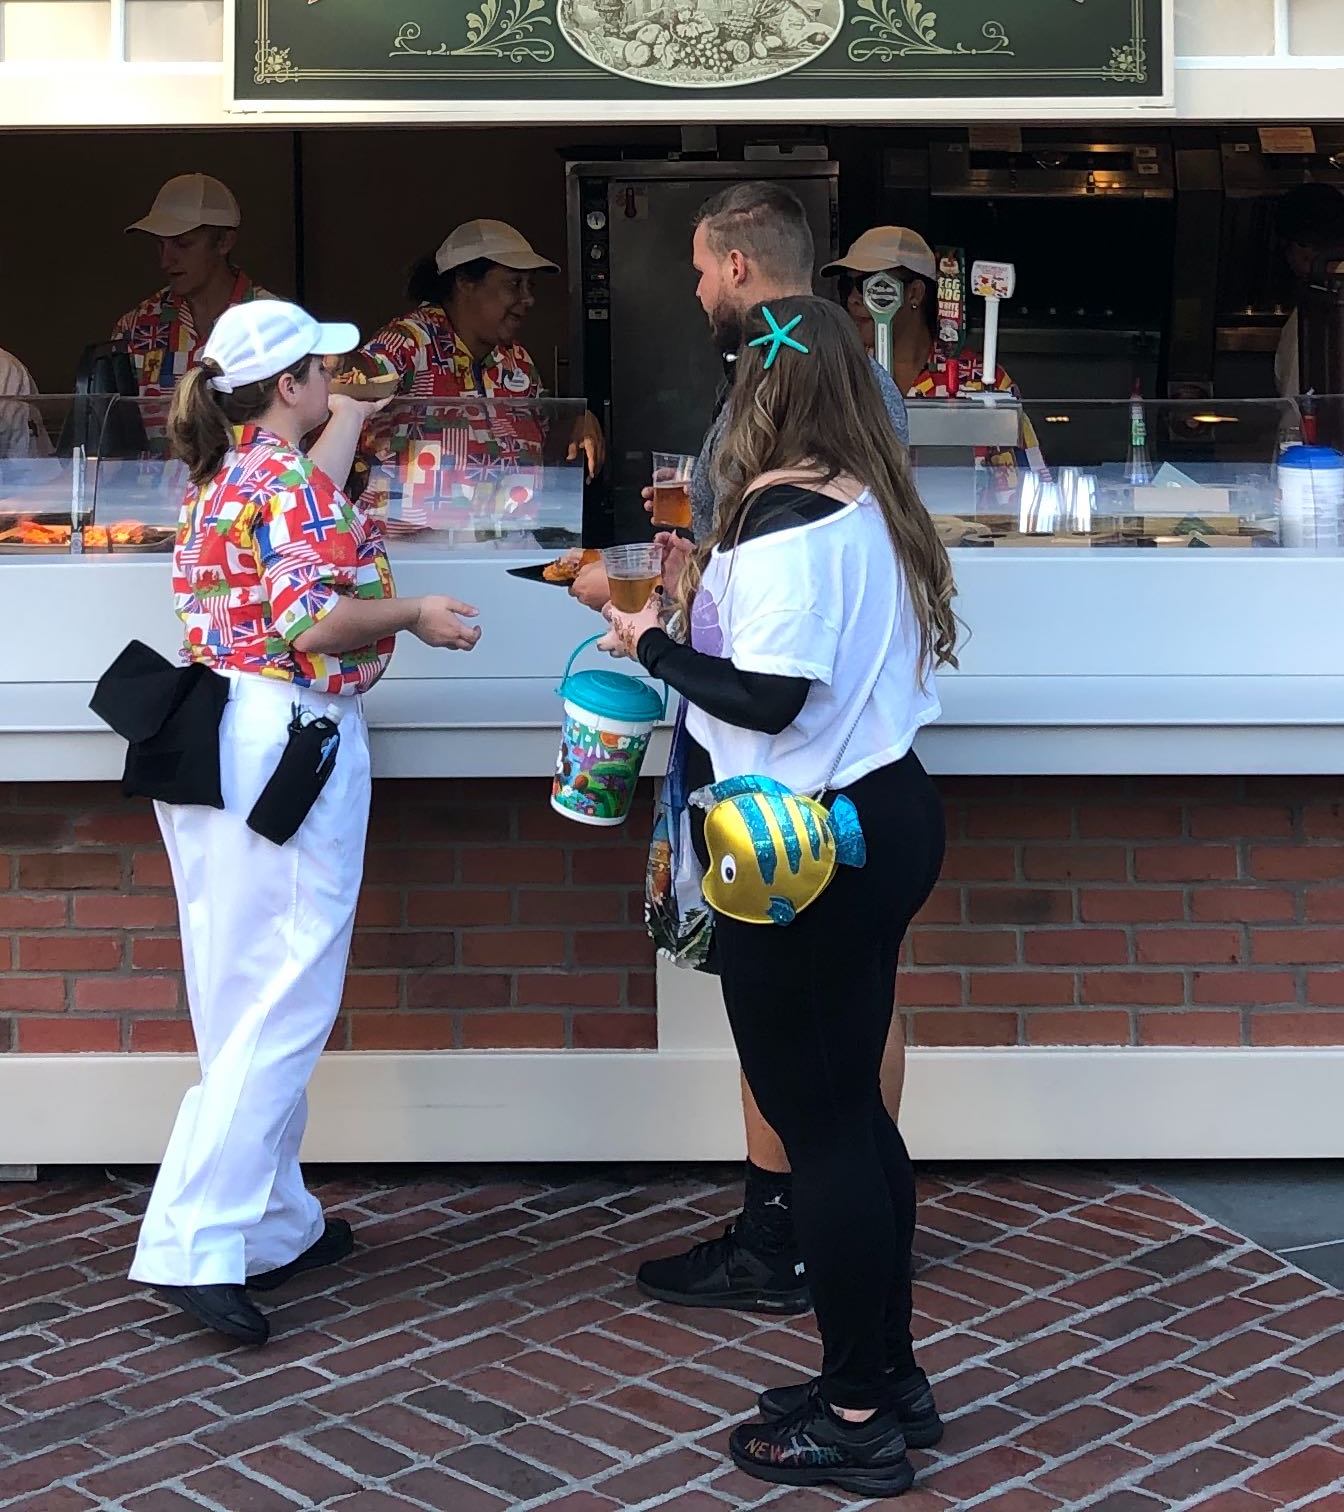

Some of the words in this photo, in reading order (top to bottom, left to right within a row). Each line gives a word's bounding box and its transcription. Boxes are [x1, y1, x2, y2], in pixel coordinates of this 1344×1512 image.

[938, 277, 961, 290] EGG
[937, 288, 961, 302] NOG
[744, 1437, 785, 1464] NEW
